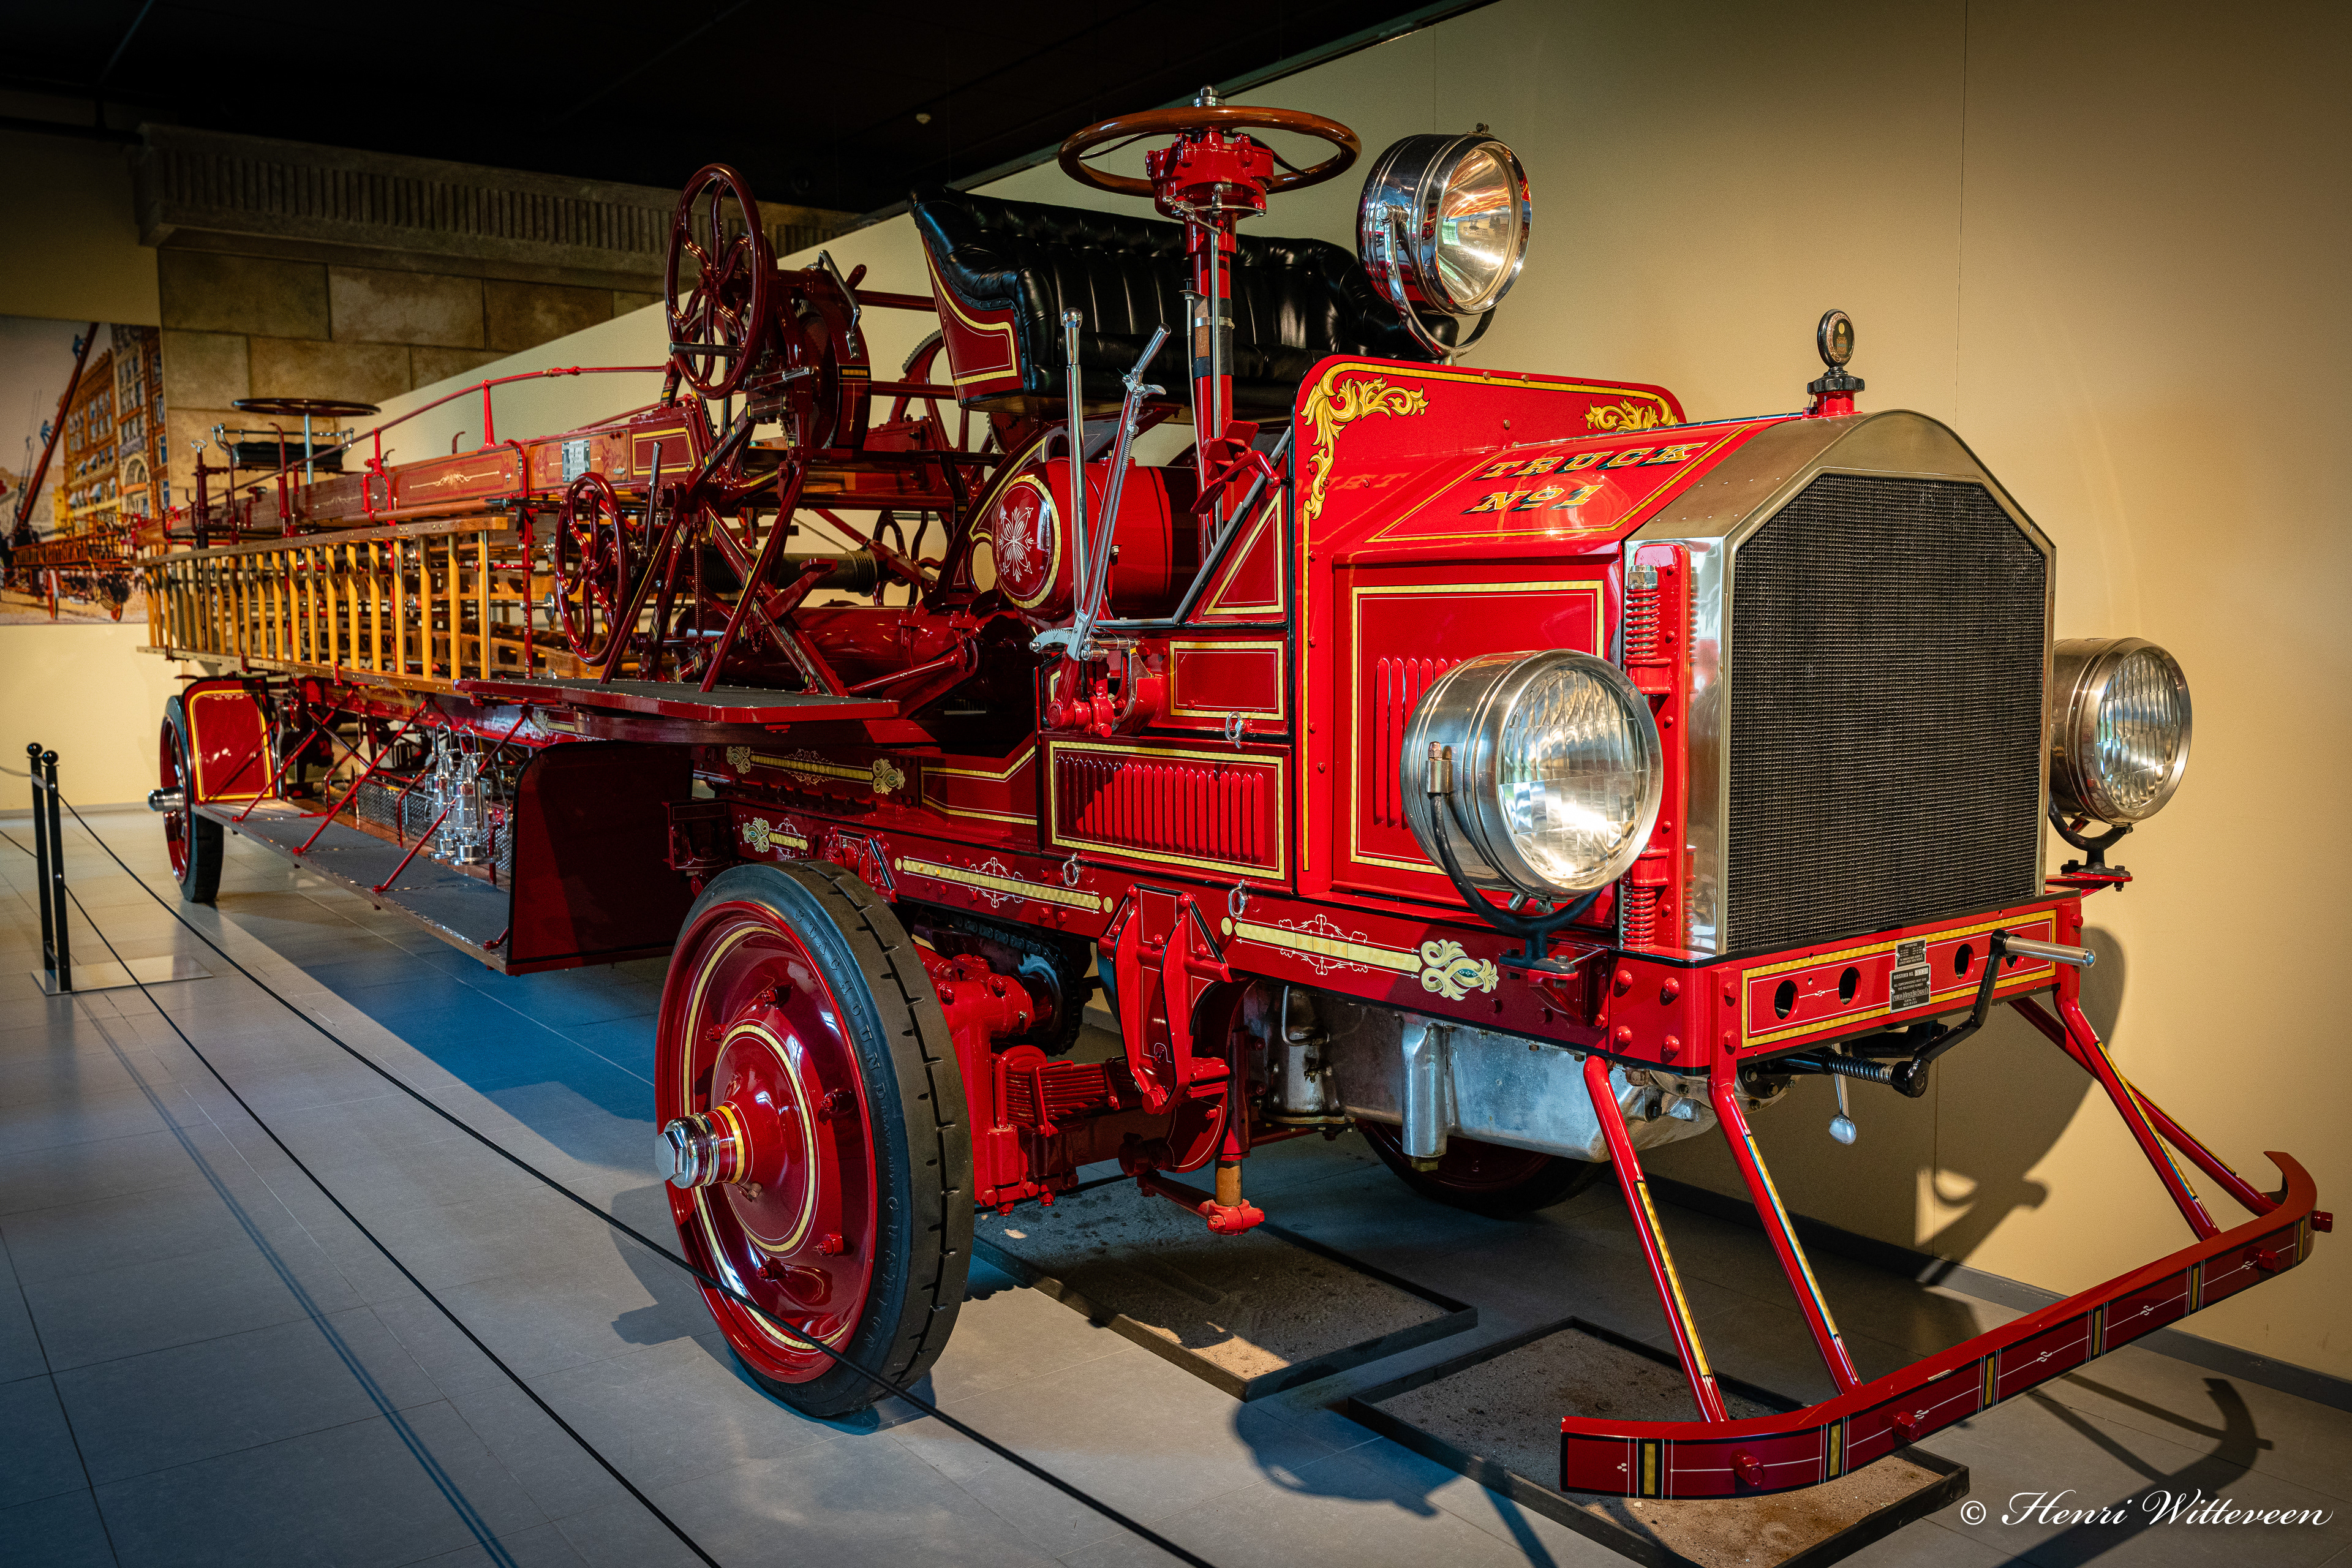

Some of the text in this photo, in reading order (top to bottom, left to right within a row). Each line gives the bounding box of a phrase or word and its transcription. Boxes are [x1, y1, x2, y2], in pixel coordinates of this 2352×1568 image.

[1475, 442, 1708, 481] TRUCK
[794, 908, 886, 1100] STAGHOUND
[863, 1196, 899, 1349] CUSHION
